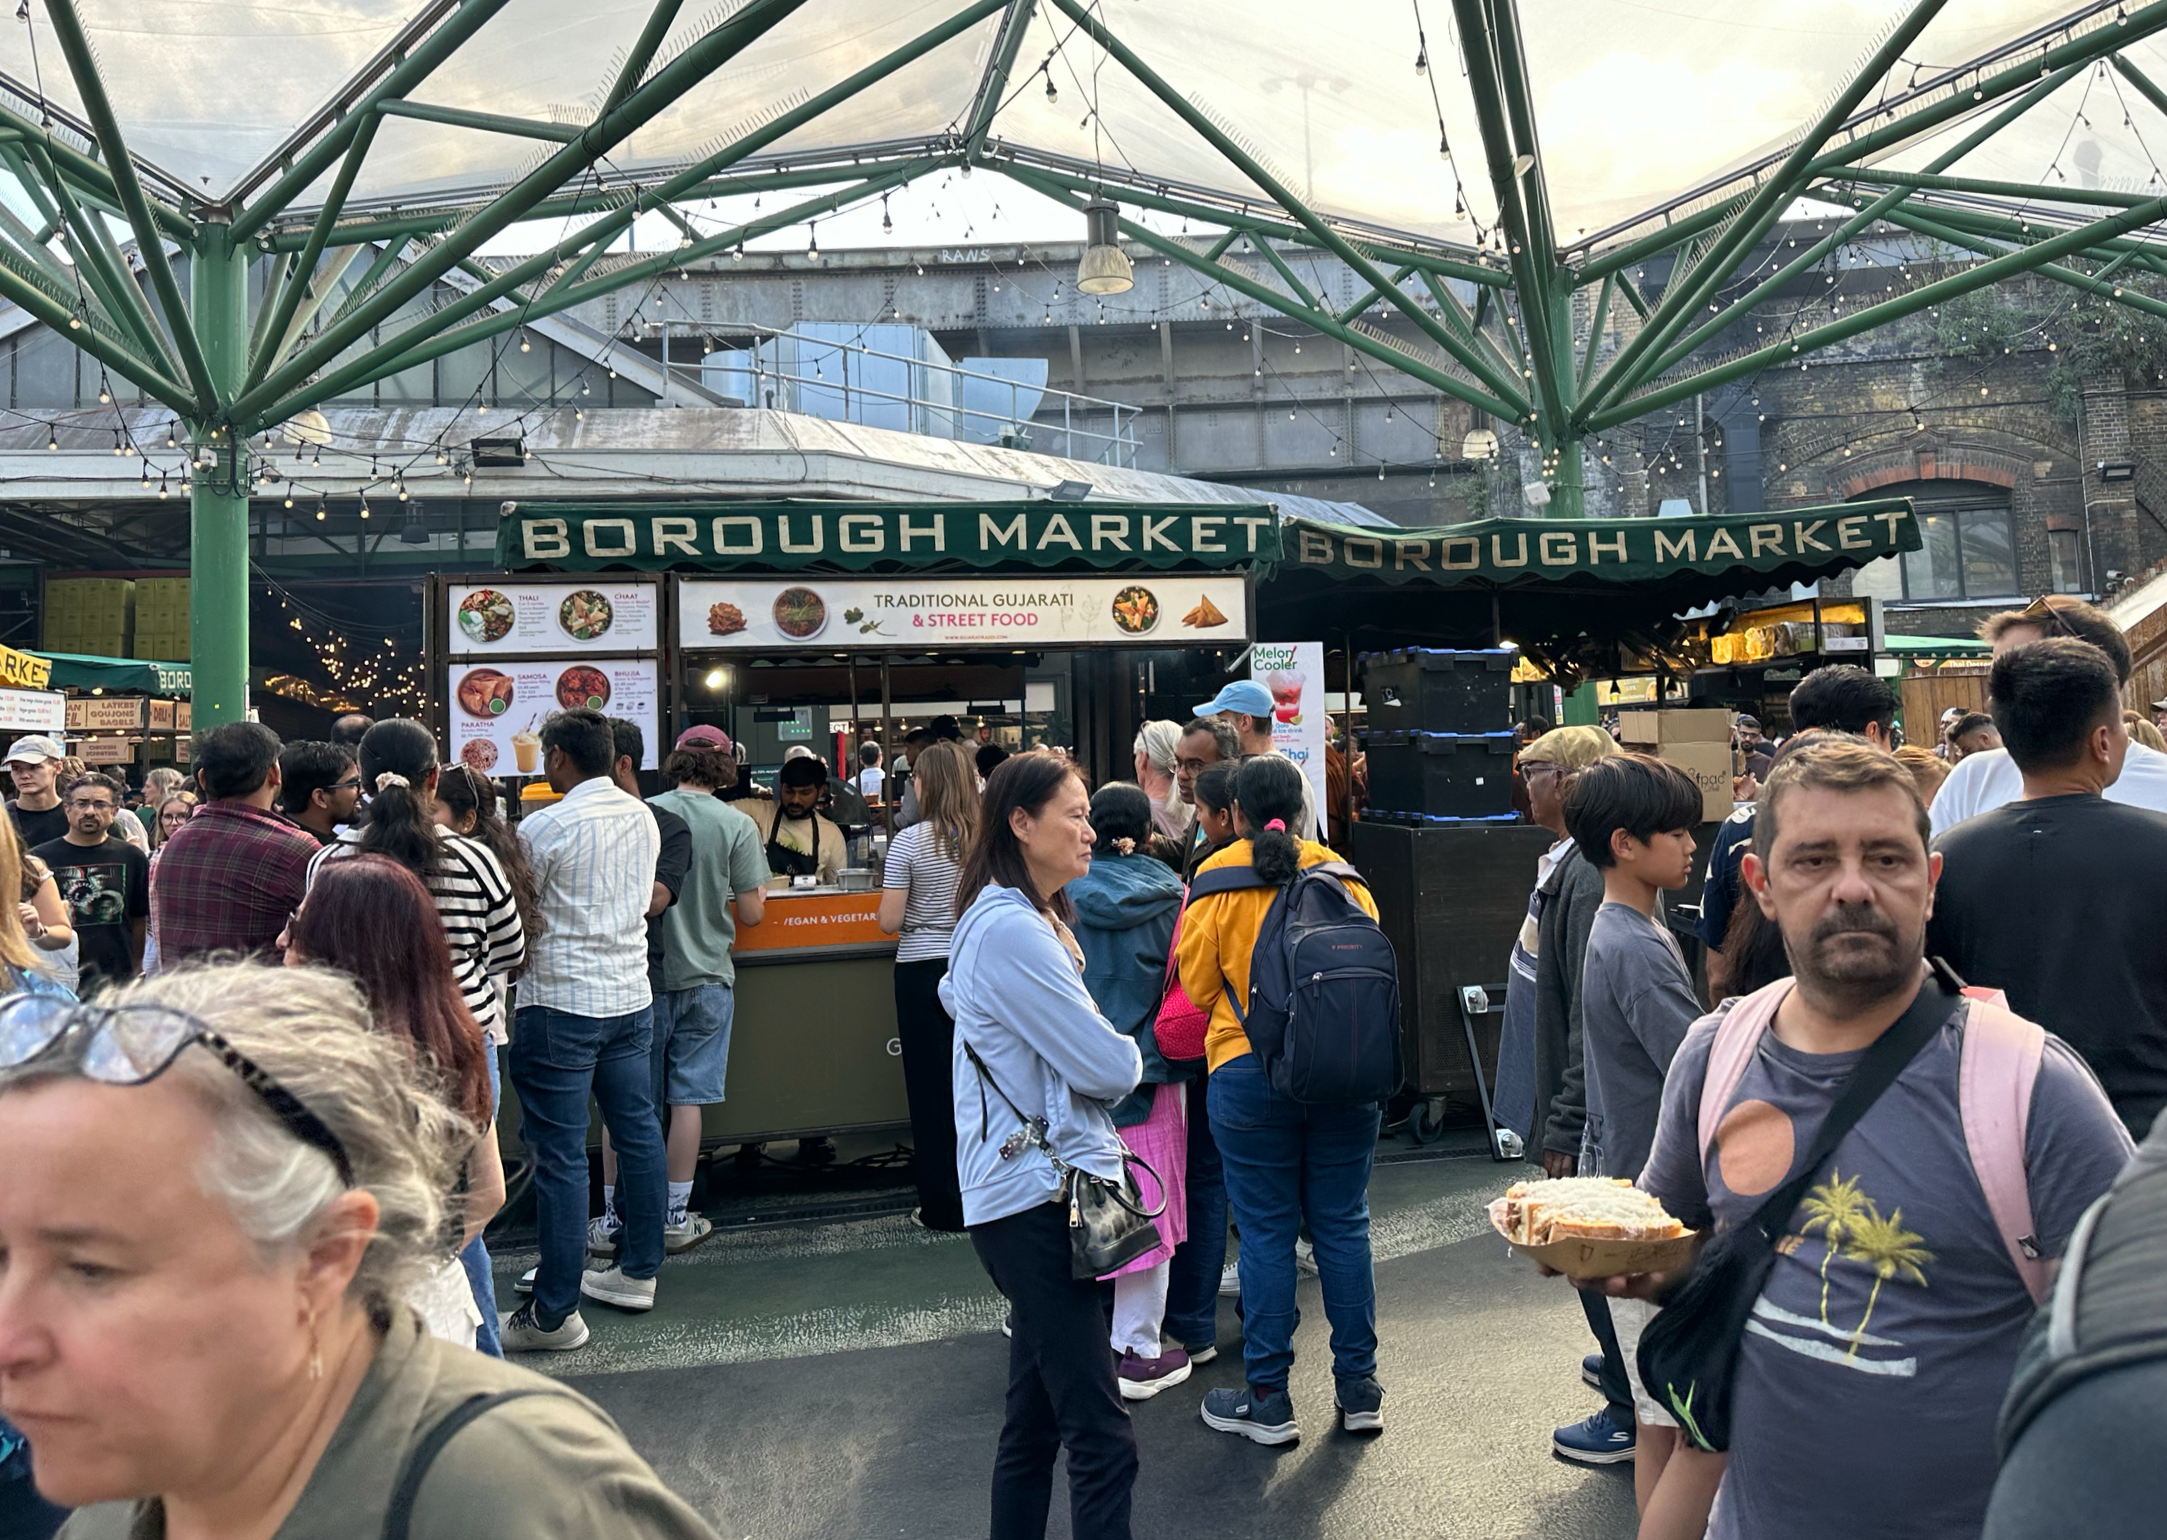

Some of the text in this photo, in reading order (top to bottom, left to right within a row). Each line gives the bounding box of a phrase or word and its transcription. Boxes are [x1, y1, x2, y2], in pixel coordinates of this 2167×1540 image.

[521, 513, 1271, 559] BOROUGH MARKET
[1300, 511, 1908, 572] BOROUGH MARKET
[874, 593, 1074, 608] TRADITIONAL GUJARATI
[912, 613, 1038, 627] & STREET FOOD
[1254, 646, 1294, 659] Melon
[0, 653, 51, 684] RKET
[1254, 659, 1297, 671] Cooler
[154, 706, 168, 722] DELI
[820, 916, 828, 924] &
